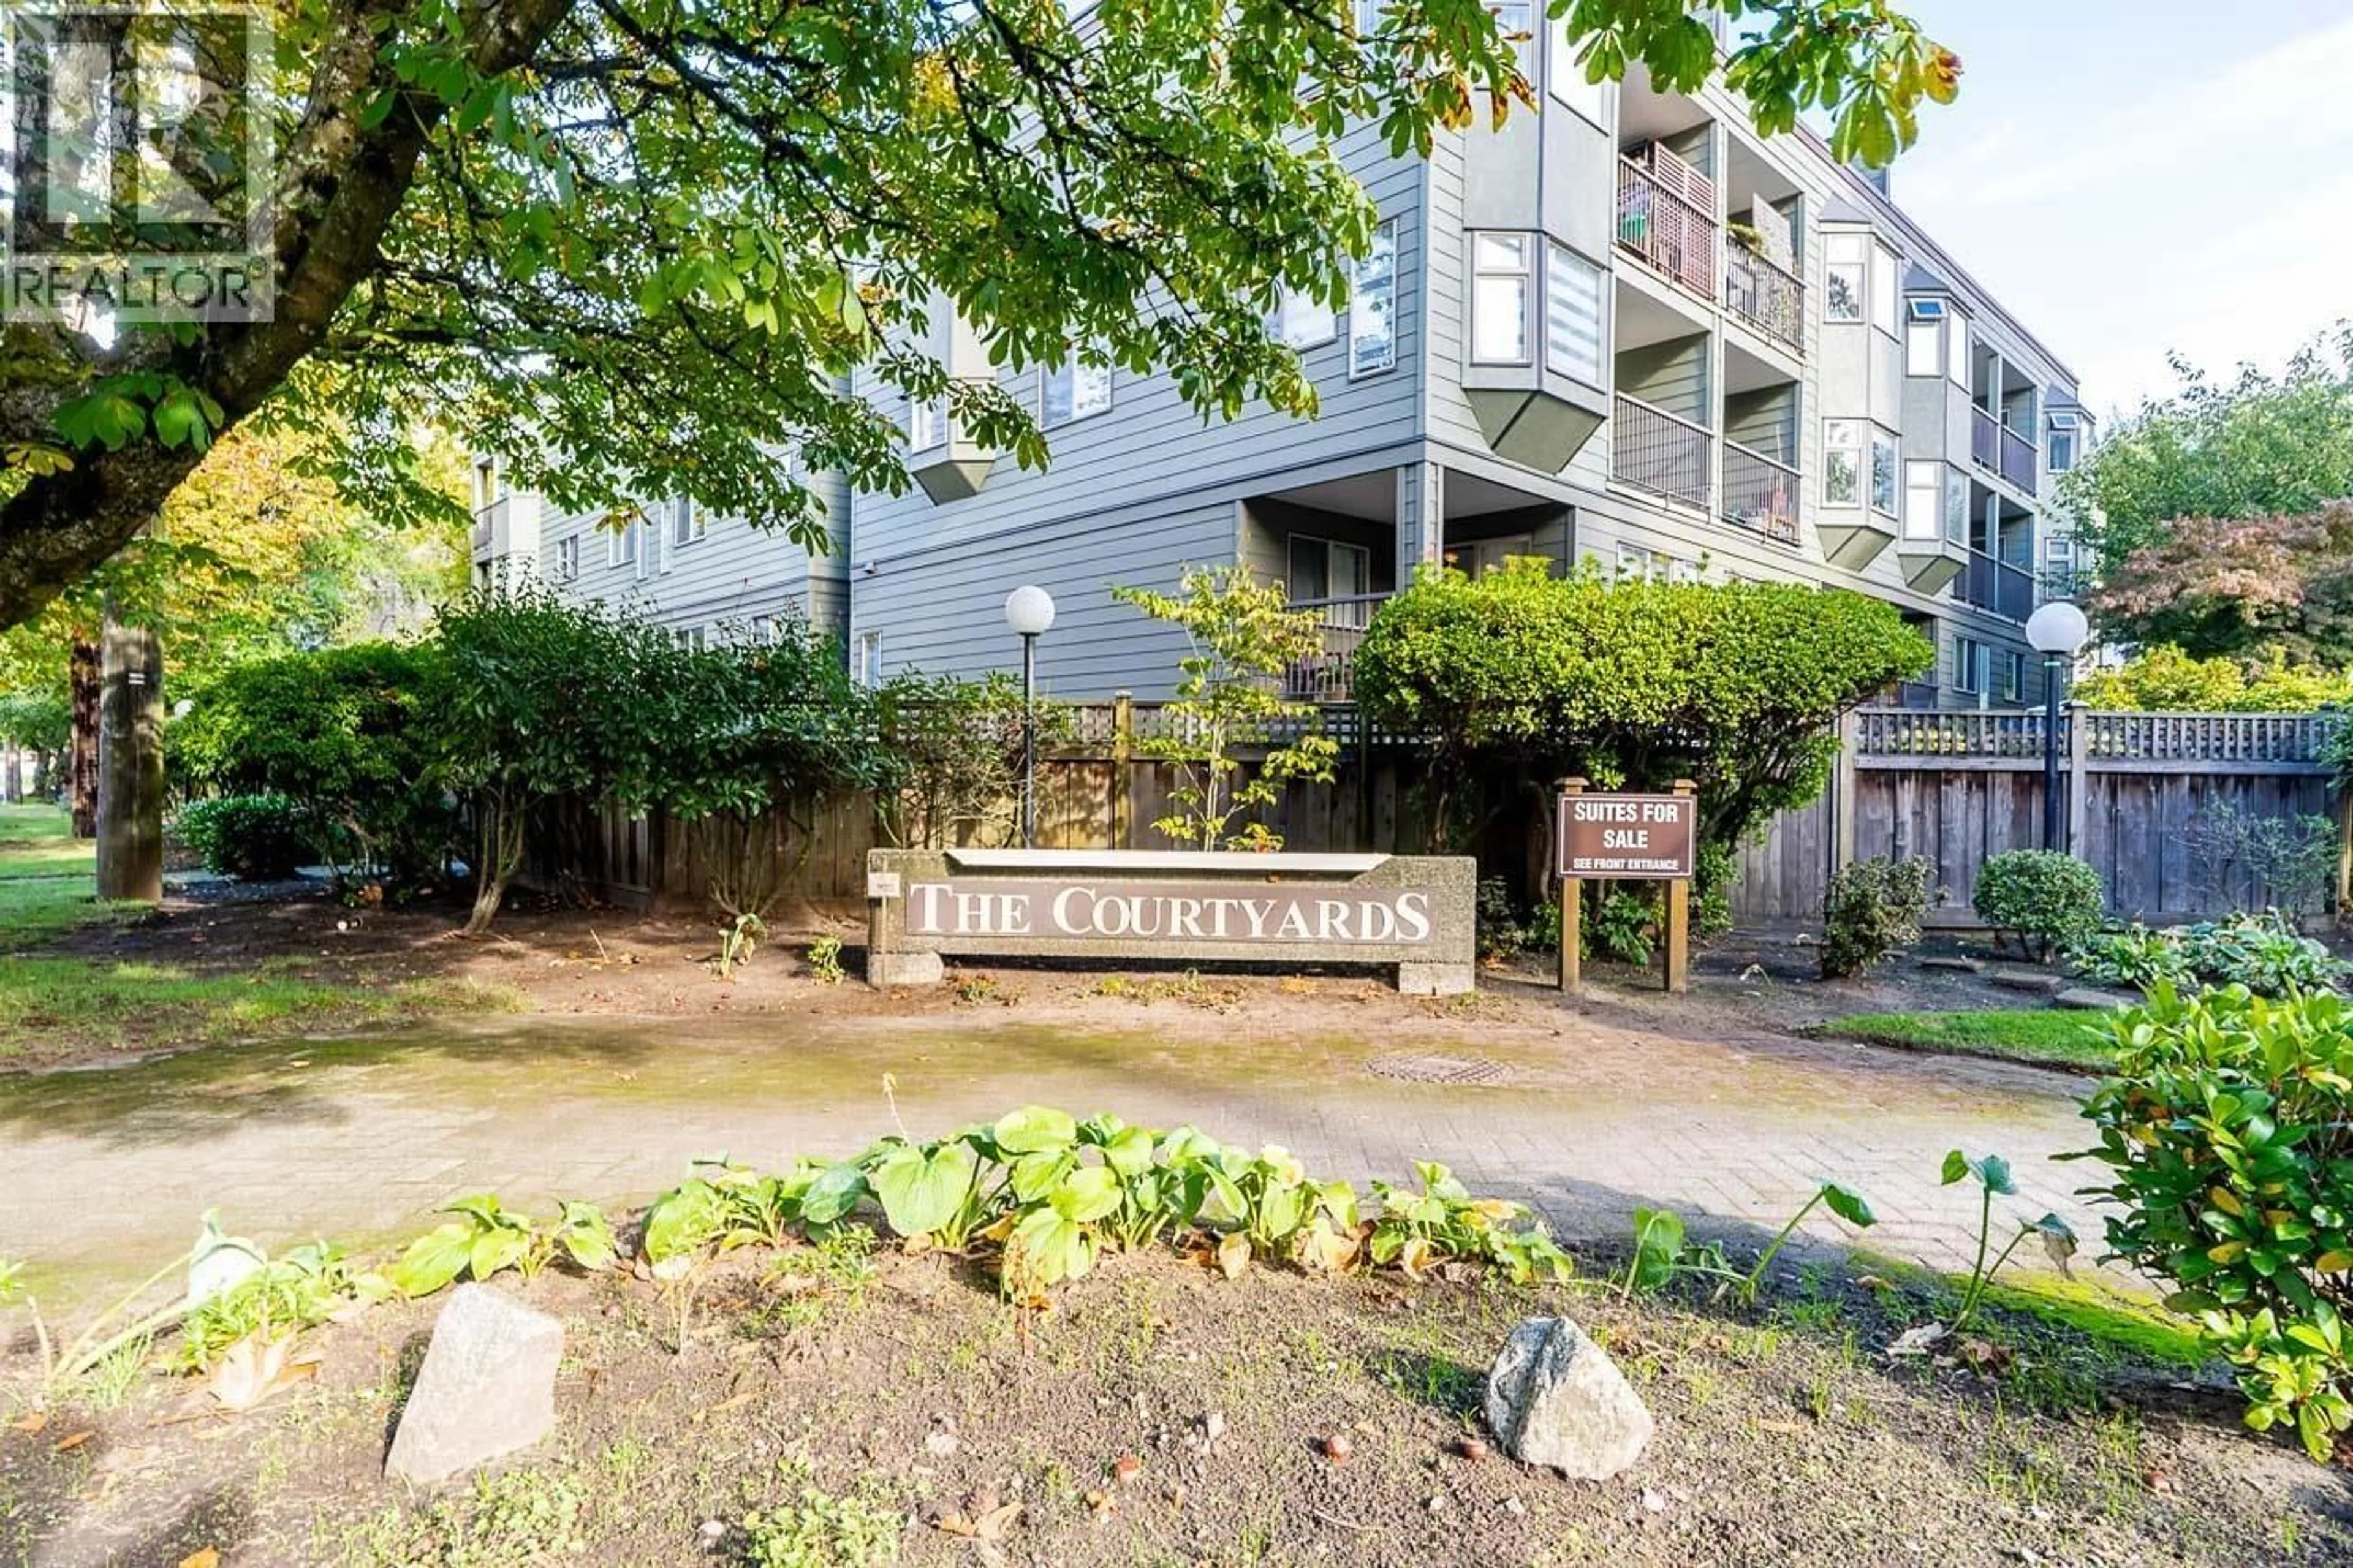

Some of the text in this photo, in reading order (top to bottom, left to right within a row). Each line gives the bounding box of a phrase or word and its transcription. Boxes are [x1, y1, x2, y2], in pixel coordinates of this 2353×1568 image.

[1574, 802, 1678, 823] SUITES FOR
[1603, 830, 1648, 848] SALE
[1574, 858, 1678, 870] SEE FRONT ENTRANCE
[909, 883, 1431, 942] THE COURTYARDS
